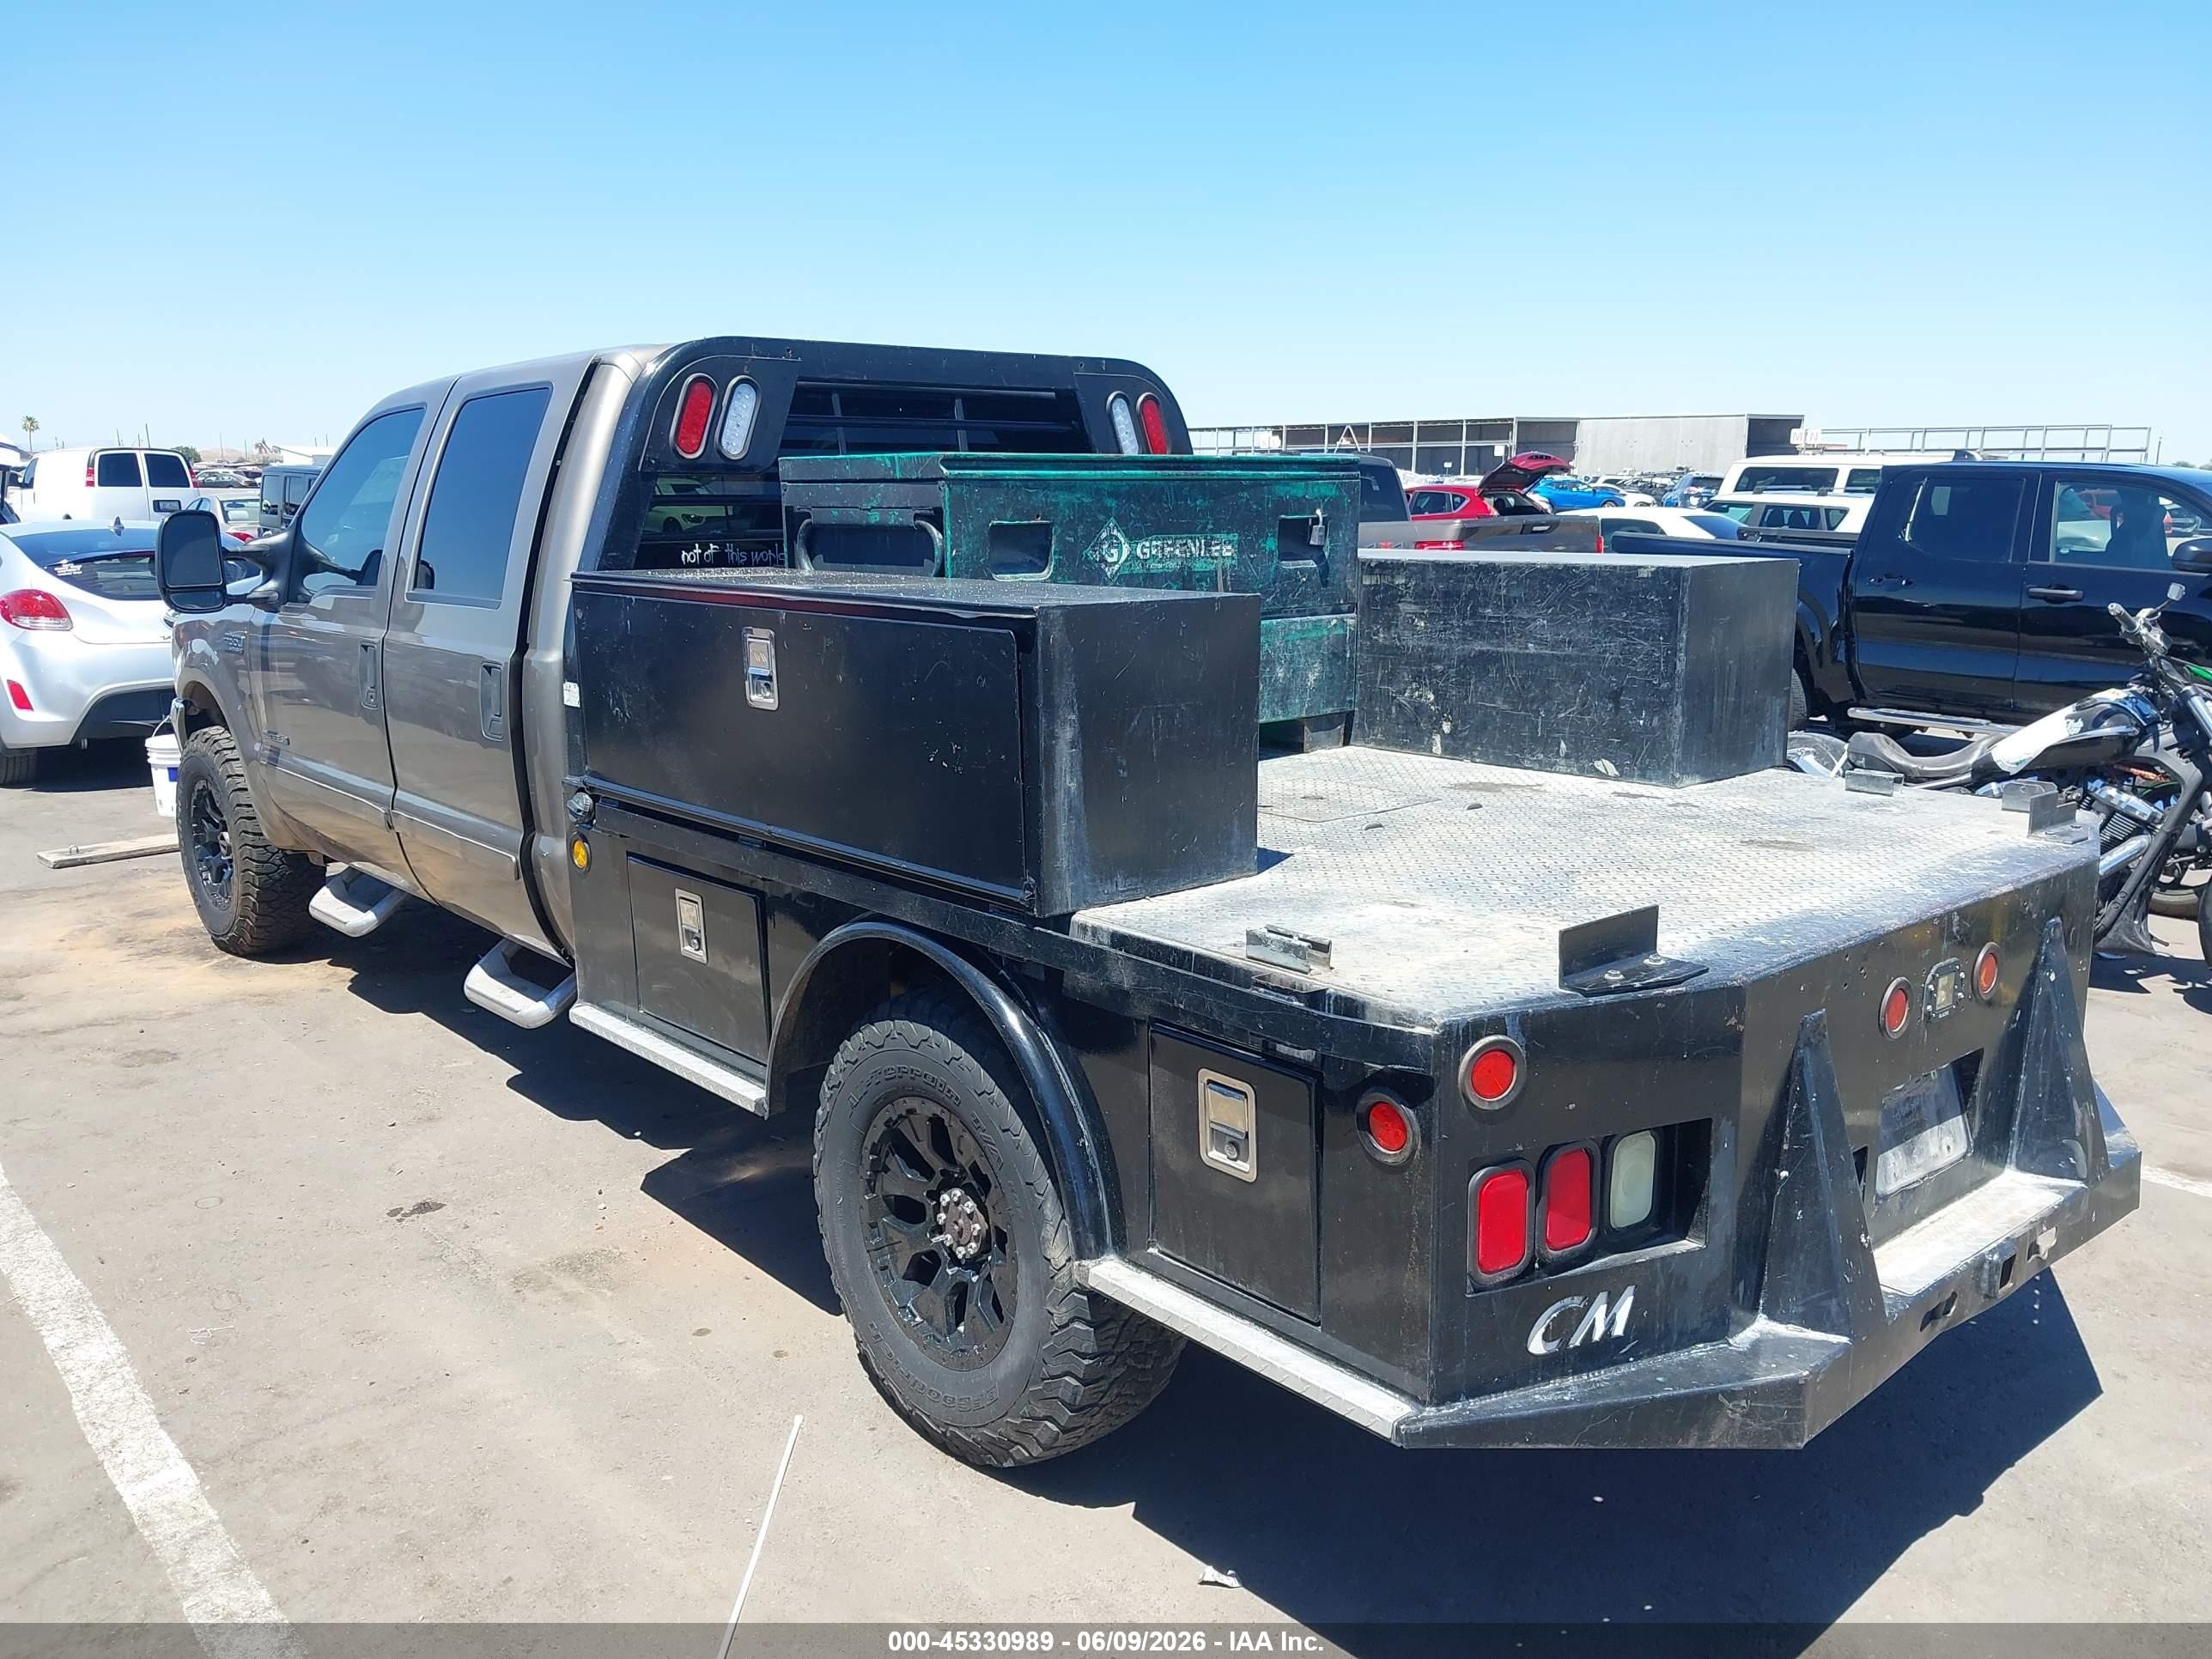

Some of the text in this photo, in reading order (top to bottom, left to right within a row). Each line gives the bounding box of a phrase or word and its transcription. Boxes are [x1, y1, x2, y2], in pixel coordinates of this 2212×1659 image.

[681, 543, 702, 565] not
[725, 543, 748, 565] this
[1526, 1285, 1637, 1356] CM
